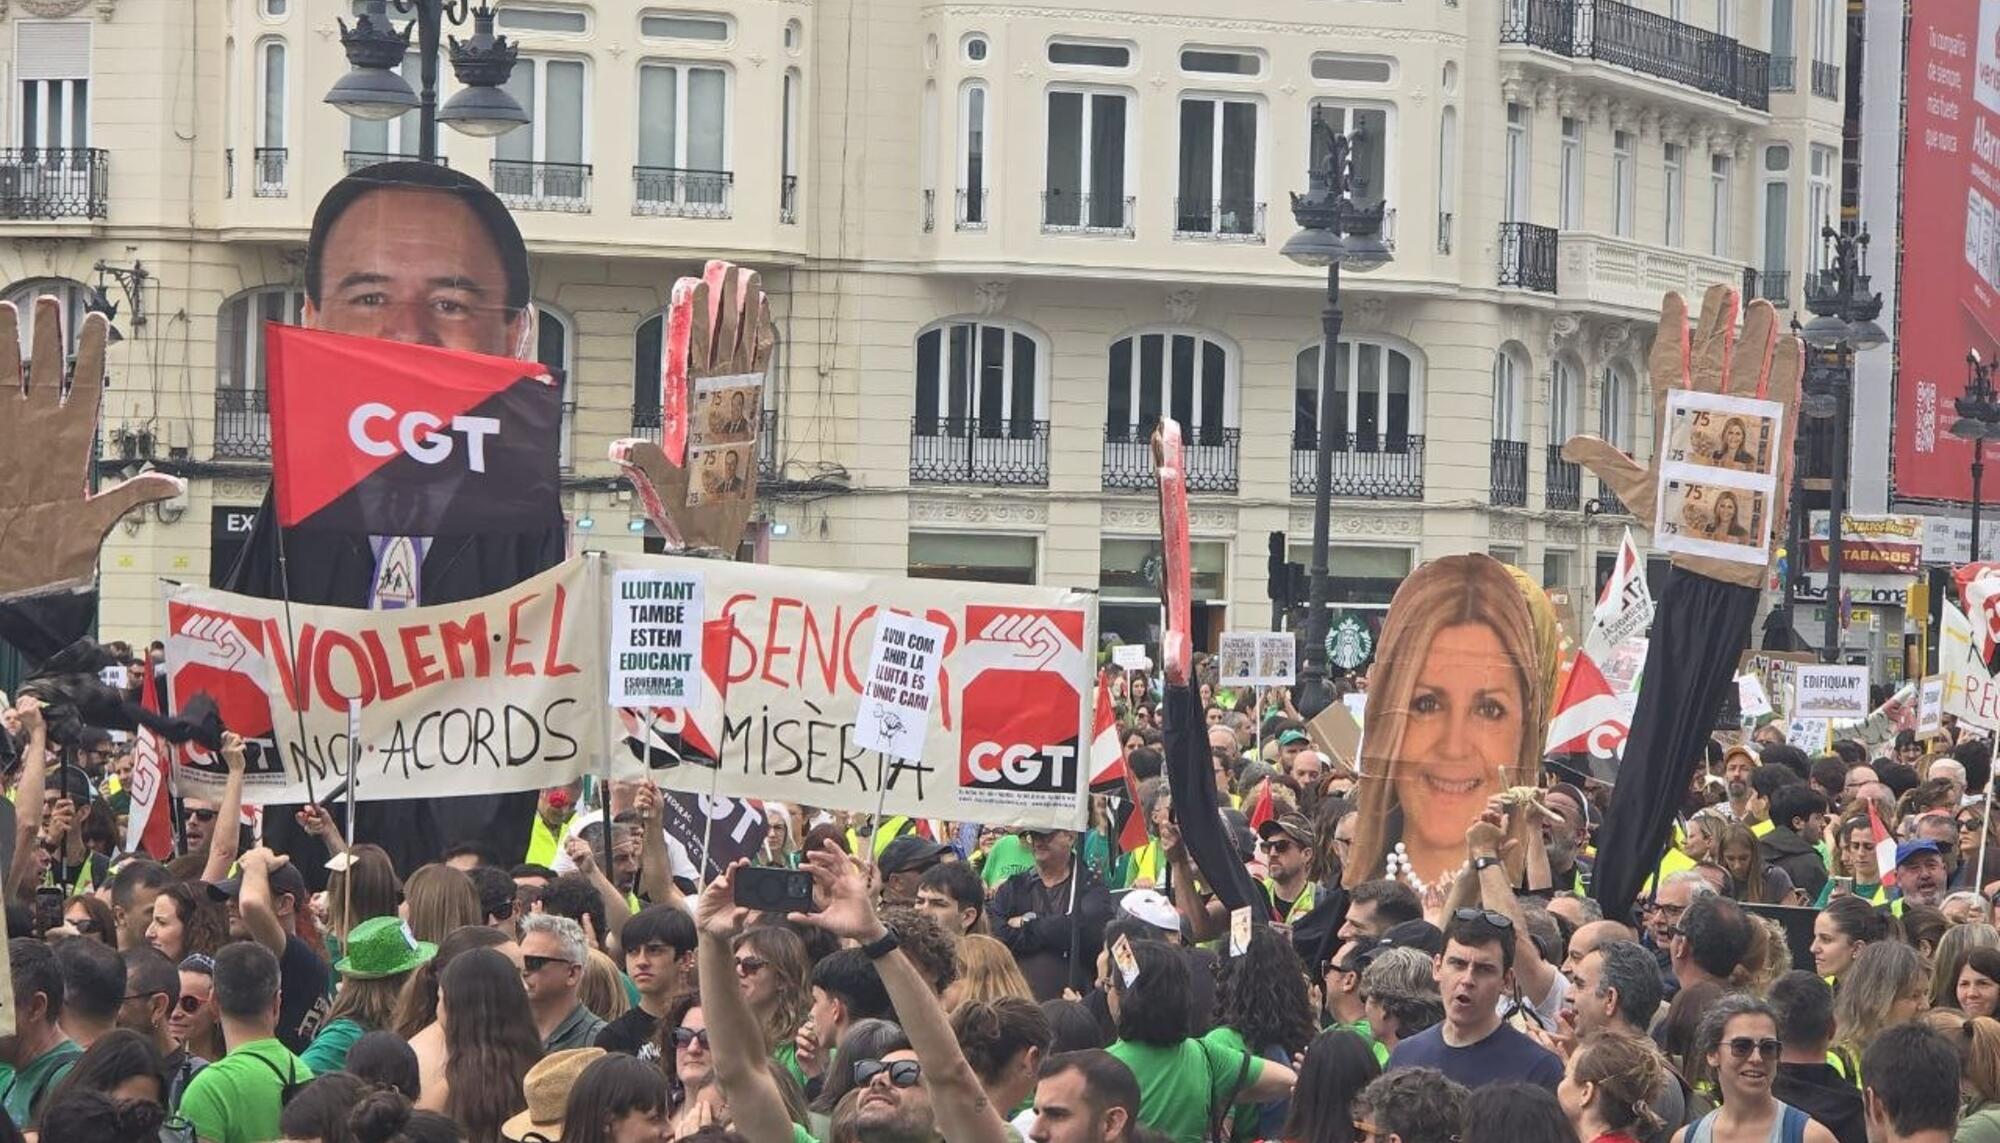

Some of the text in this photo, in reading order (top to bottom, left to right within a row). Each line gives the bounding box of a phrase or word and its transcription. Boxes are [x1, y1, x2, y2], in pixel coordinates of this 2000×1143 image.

[1691, 410, 1710, 426] 75
[348, 402, 500, 473] CGT
[704, 450, 716, 465] 75
[1672, 450, 1684, 461] 75
[1684, 483, 1703, 500] 75
[1665, 522, 1678, 534] 75
[1843, 549, 1911, 563] TABACOS
[621, 581, 695, 600] LLUITANT
[630, 601, 685, 624] TAMBÉ
[630, 628, 682, 648] ESTEM
[882, 627, 935, 654] AVUI COM
[620, 652, 693, 671] EDUCANT
[721, 594, 958, 732] SENCR
[882, 647, 924, 670] AHIR LA
[875, 664, 908, 686] LLUITA
[1803, 675, 1861, 689] EDIFIQUAN?
[185, 737, 275, 770] CT
[967, 741, 1075, 787] CGT
